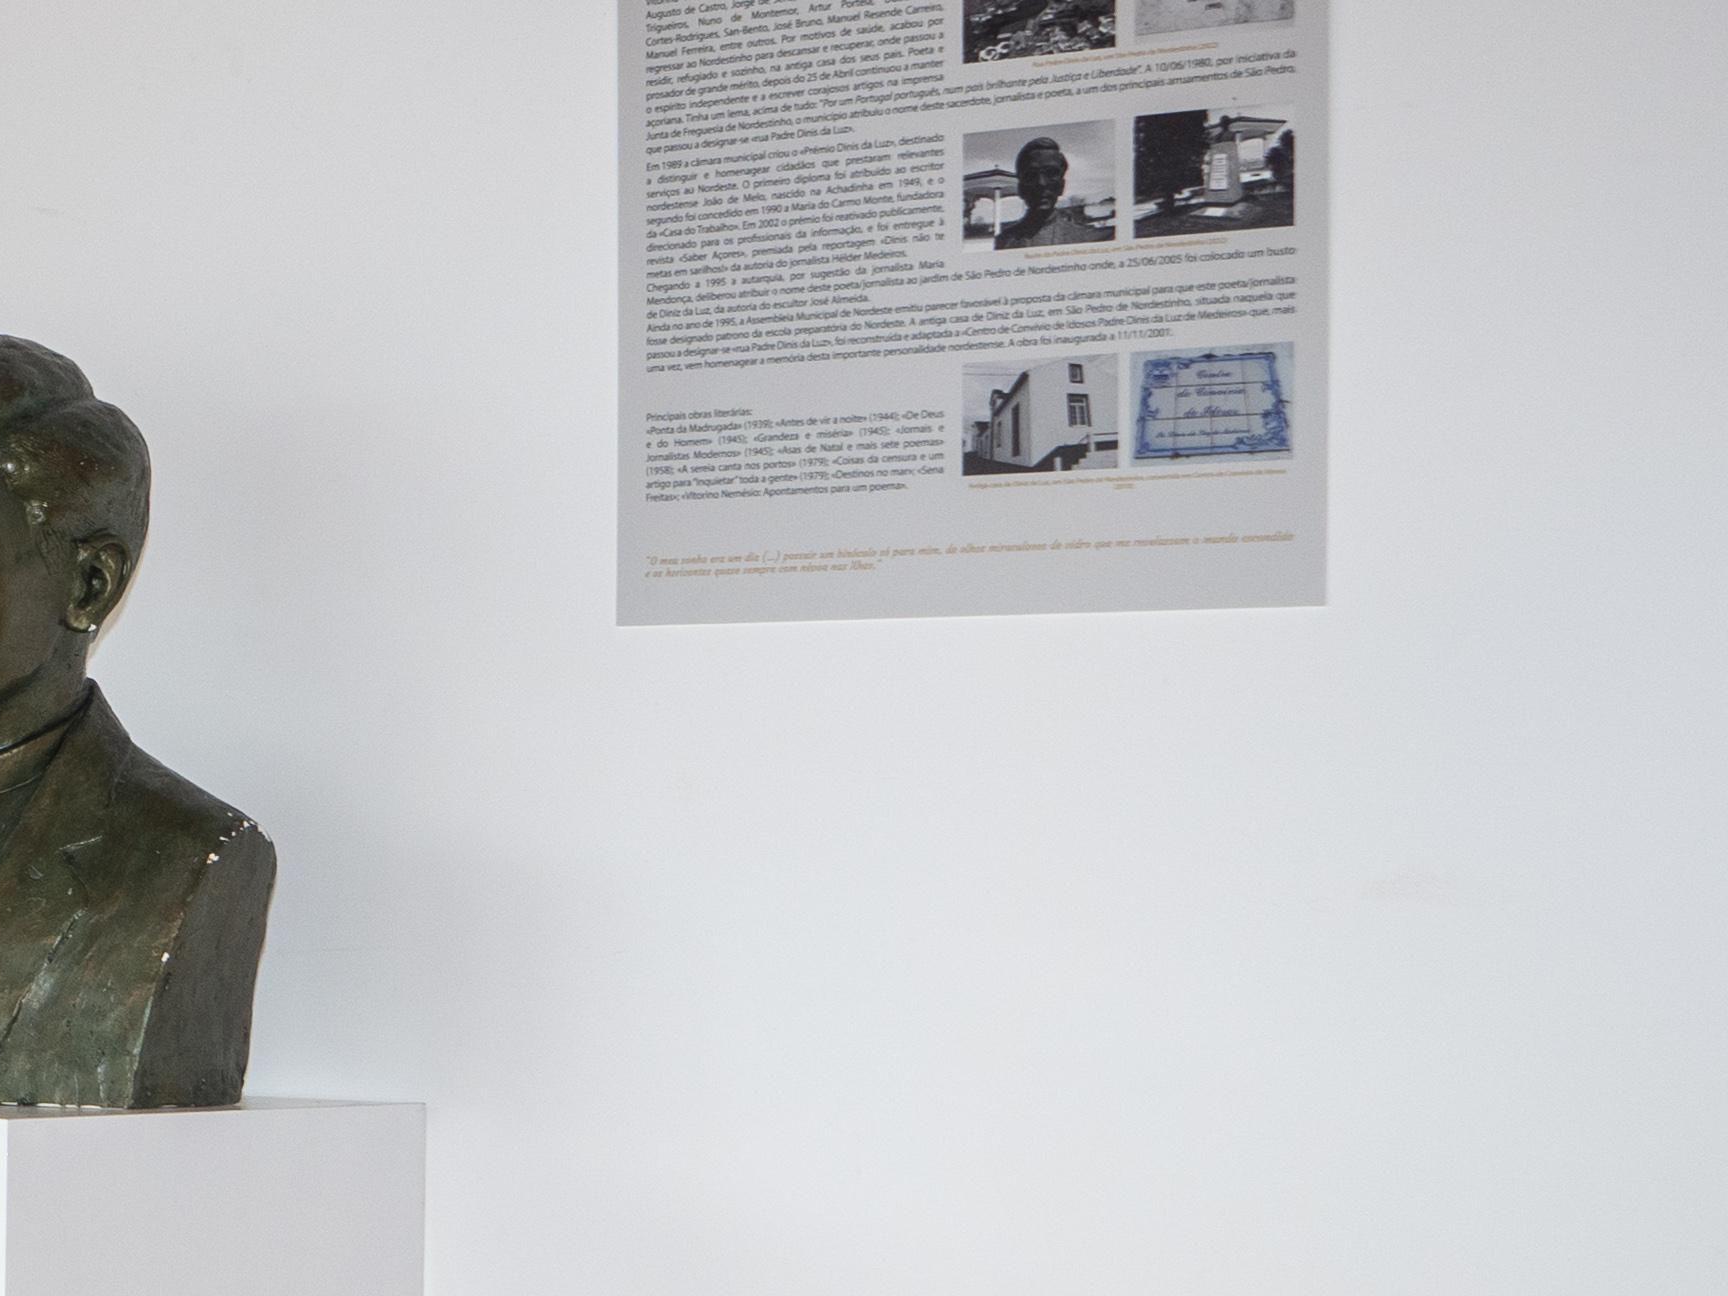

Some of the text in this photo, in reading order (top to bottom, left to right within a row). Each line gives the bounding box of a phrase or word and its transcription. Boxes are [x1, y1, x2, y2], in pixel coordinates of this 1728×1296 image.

[645, 407, 752, 422] Principais obras literárias:
